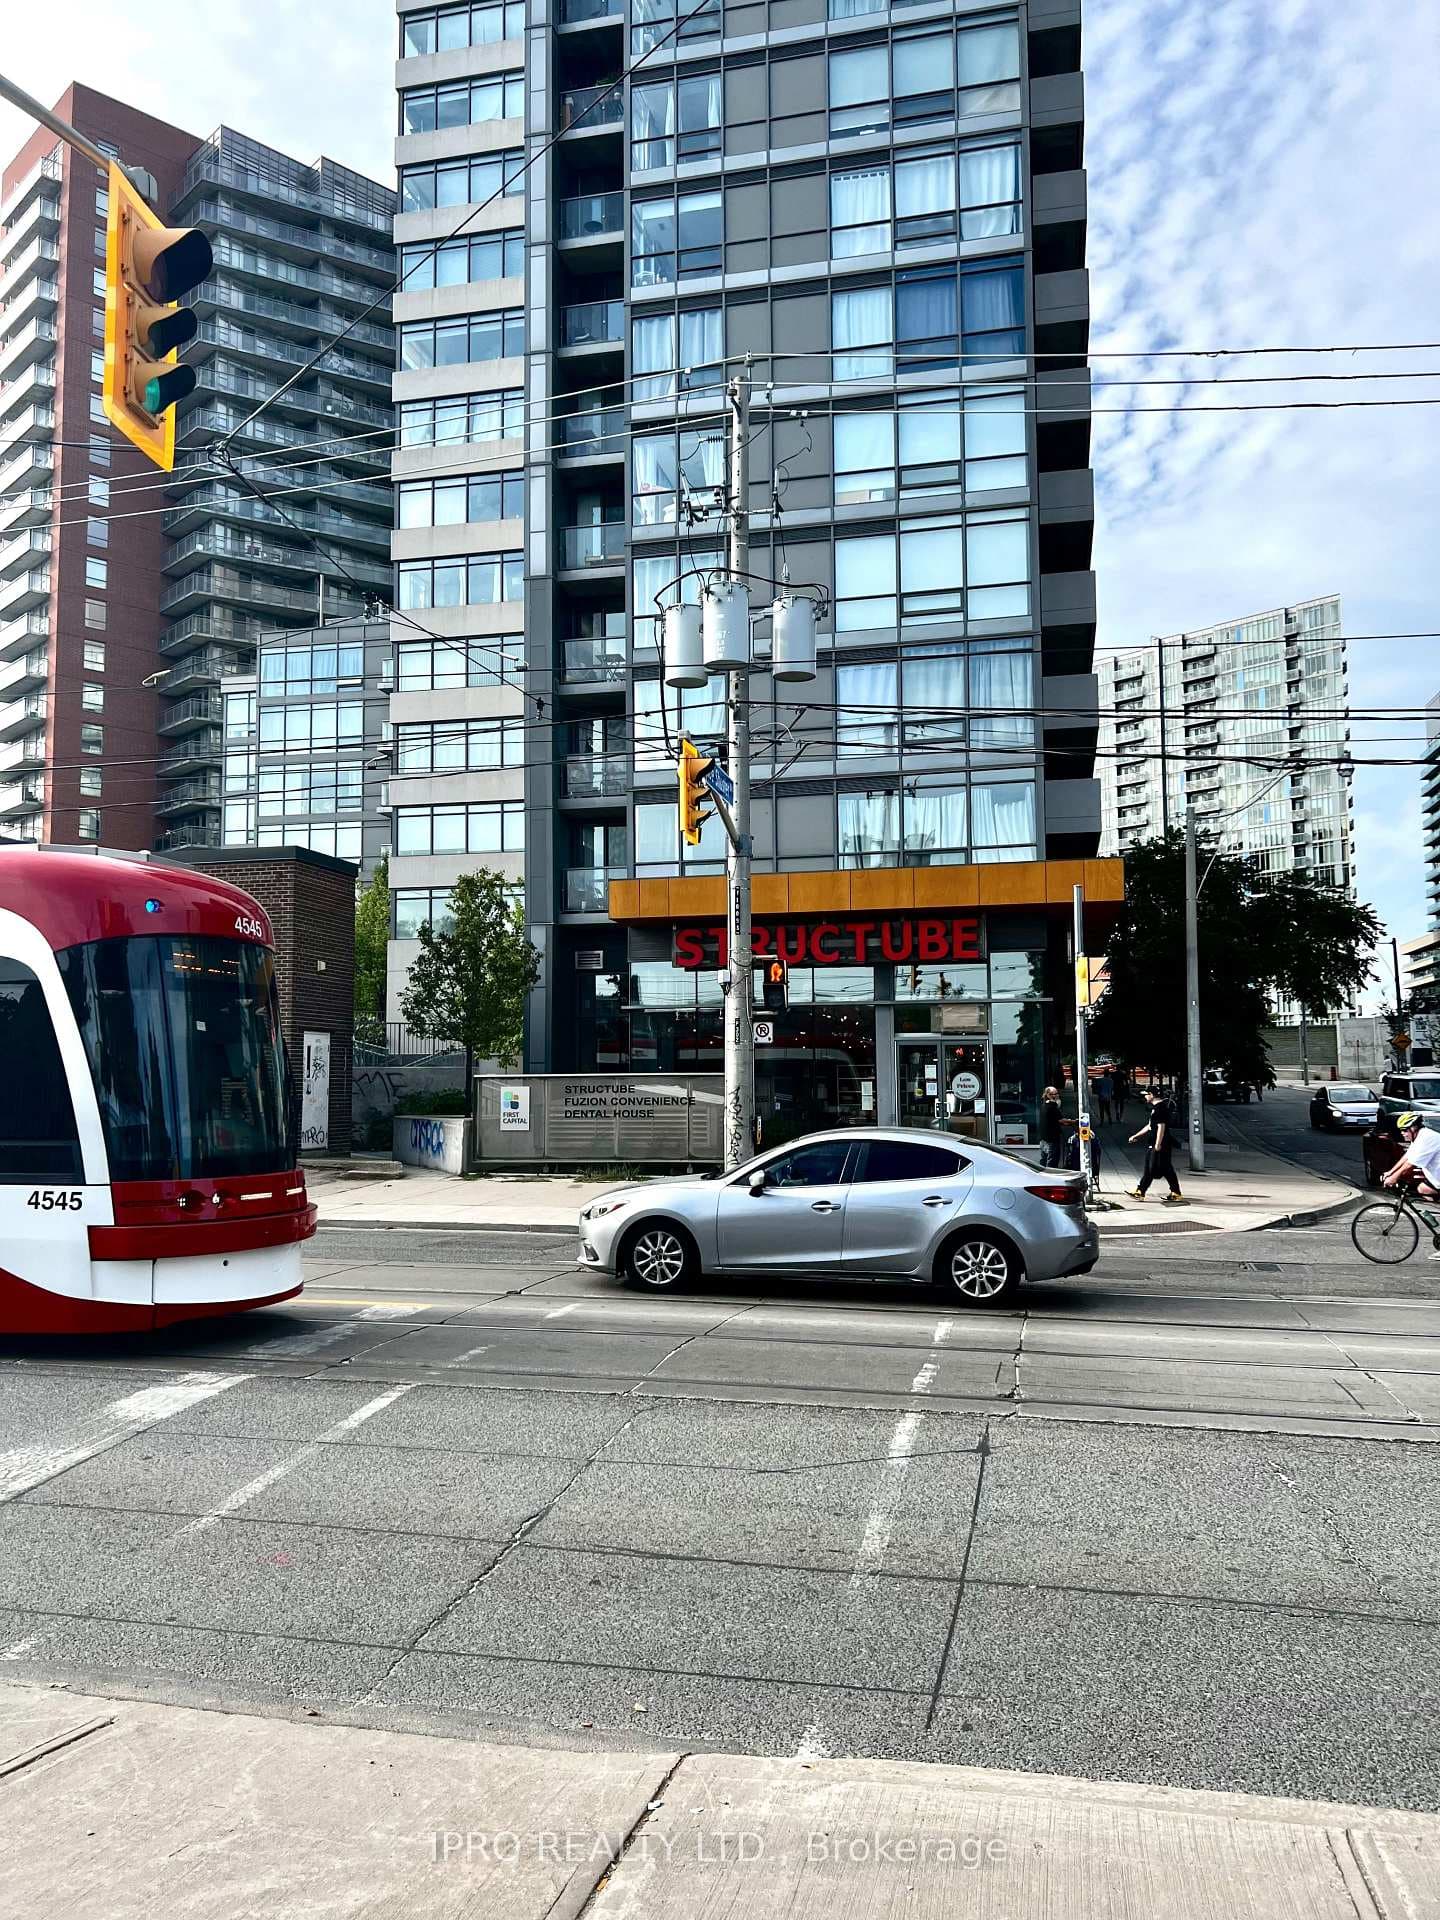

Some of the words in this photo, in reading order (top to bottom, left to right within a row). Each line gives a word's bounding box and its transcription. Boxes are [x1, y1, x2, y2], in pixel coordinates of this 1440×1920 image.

[234, 916, 262, 938] 4545
[675, 918, 981, 969] STRUCTUBE
[564, 1084, 636, 1094] STRUCTUBE
[564, 1096, 607, 1107] FUZION
[612, 1096, 696, 1106] CONVENIENCE
[564, 1109, 609, 1119] DENTAL
[613, 1109, 655, 1119] HOUSE
[502, 1117, 528, 1125] CAPITAL
[27, 1190, 83, 1211] 4545
